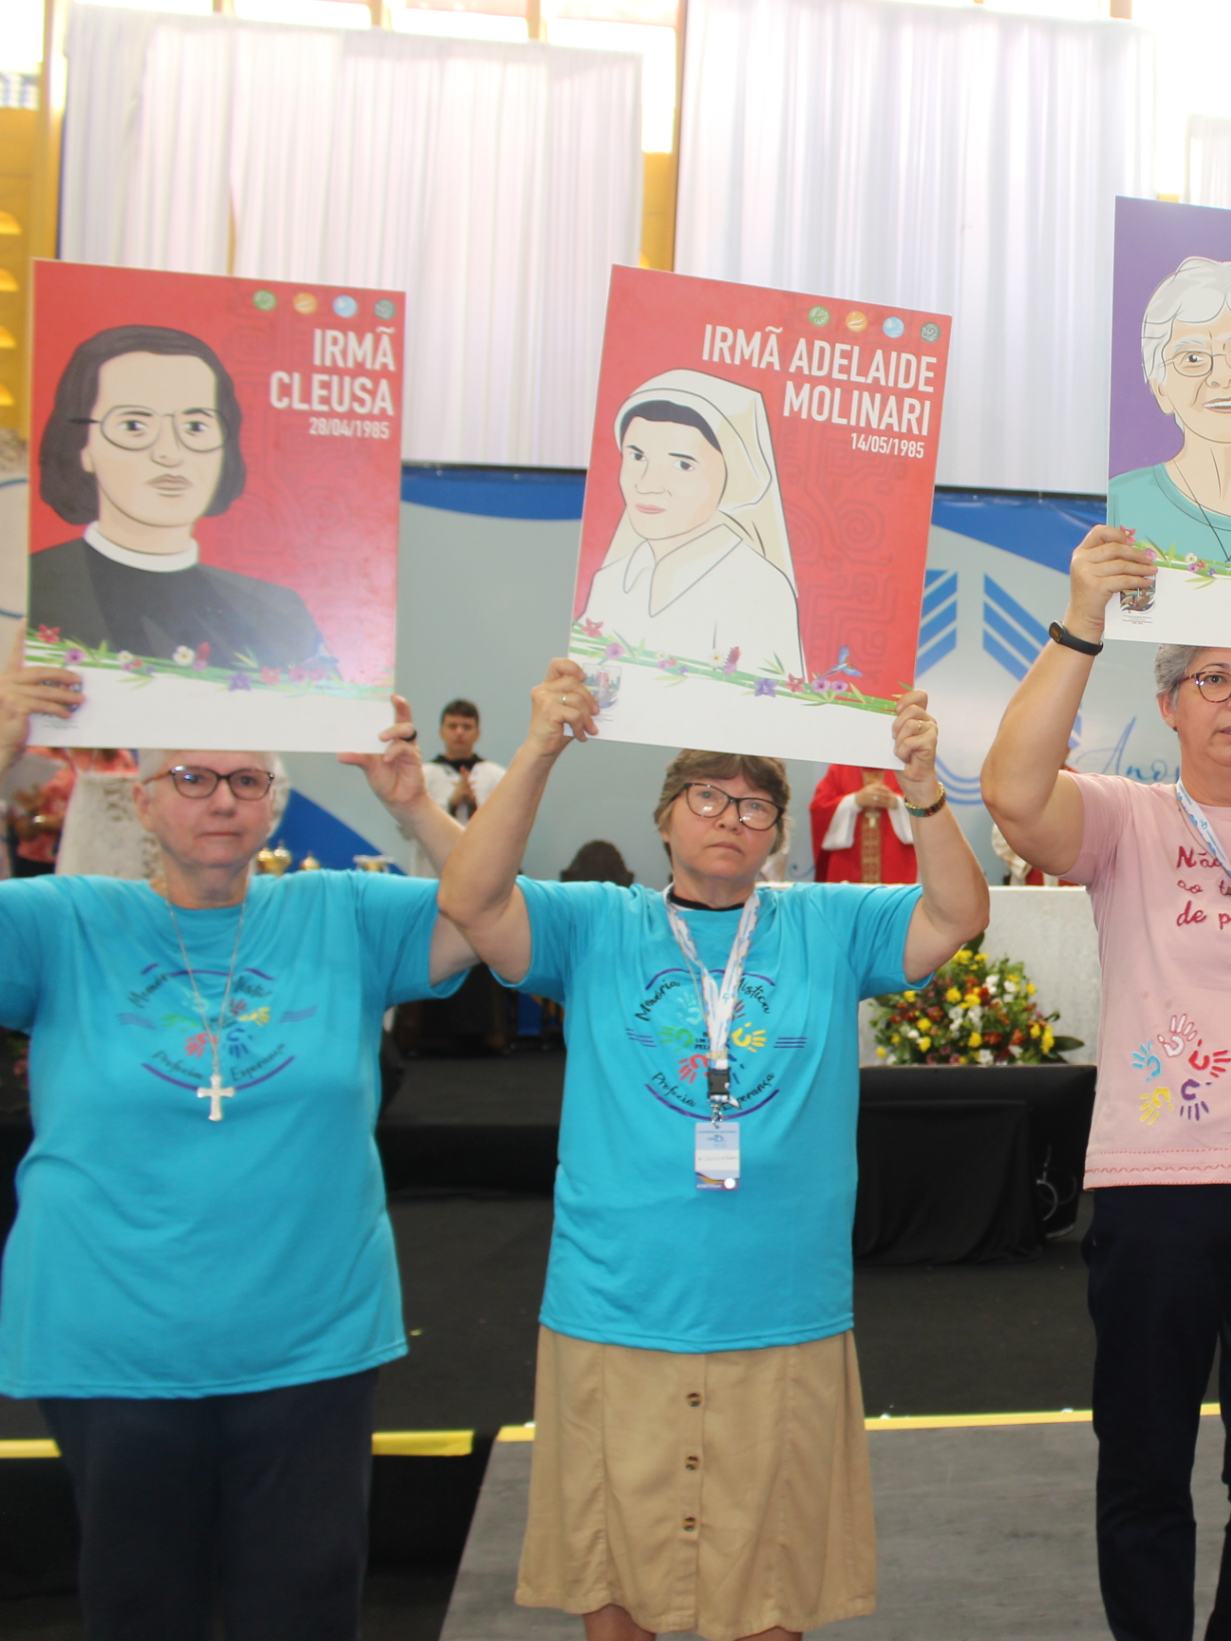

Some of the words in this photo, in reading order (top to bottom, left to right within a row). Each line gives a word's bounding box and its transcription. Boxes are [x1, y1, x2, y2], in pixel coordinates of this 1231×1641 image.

[313, 326, 396, 372] IRMÃ
[701, 324, 784, 371] IRMÃ
[788, 337, 937, 393] ADELAIDE
[269, 370, 394, 416] CLEUSA
[782, 380, 931, 436] MOLINARI
[309, 417, 390, 440] 28/04/1985
[850, 432, 925, 459] 14/05/1985
[1177, 879, 1203, 895] ao
[1176, 900, 1208, 927] de
